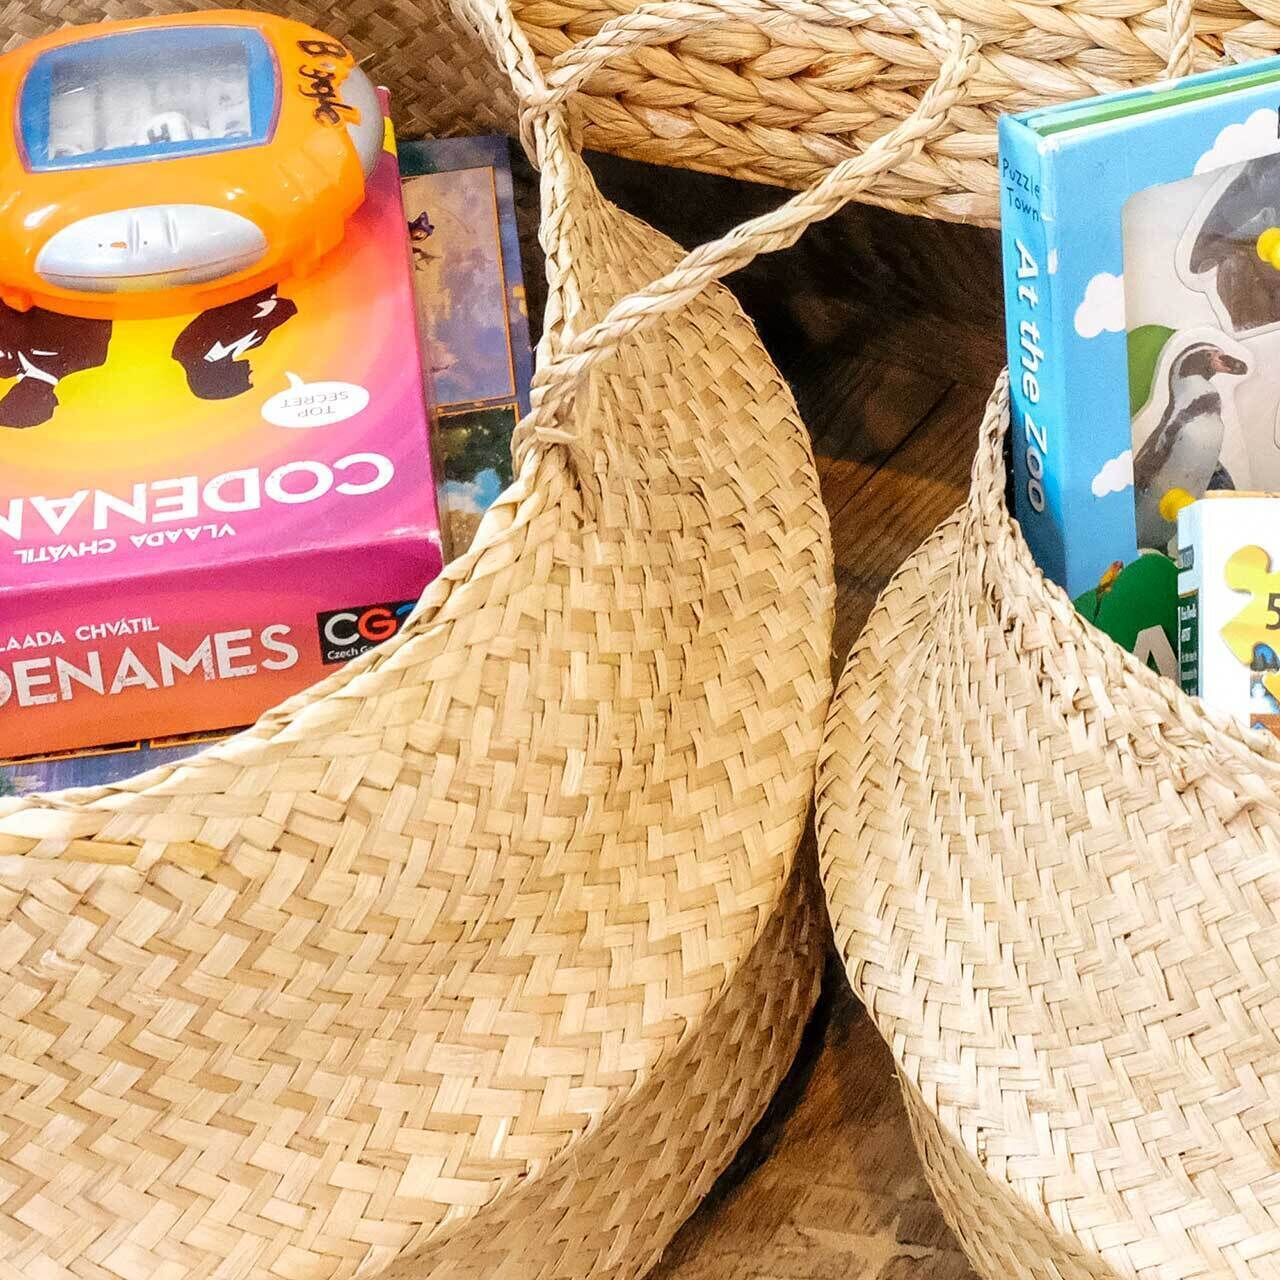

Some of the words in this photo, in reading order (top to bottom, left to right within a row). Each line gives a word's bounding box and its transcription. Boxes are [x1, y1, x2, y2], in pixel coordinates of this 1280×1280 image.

[297, 40, 353, 124] Bggle
[1002, 157, 1040, 200] Puzzle
[1006, 186, 1040, 222] Town
[1015, 238, 1039, 310] At
[1020, 321, 1045, 405] the
[280, 391, 349, 408] SECRET
[297, 405, 336, 418] TOP
[1024, 412, 1048, 512] Zoo
[13, 537, 118, 564] CHVÁTIL
[129, 521, 237, 549] VLAADA
[74, 616, 160, 642] CHVÁTIL
[324, 603, 417, 647] CG
[327, 647, 359, 660] Czech
